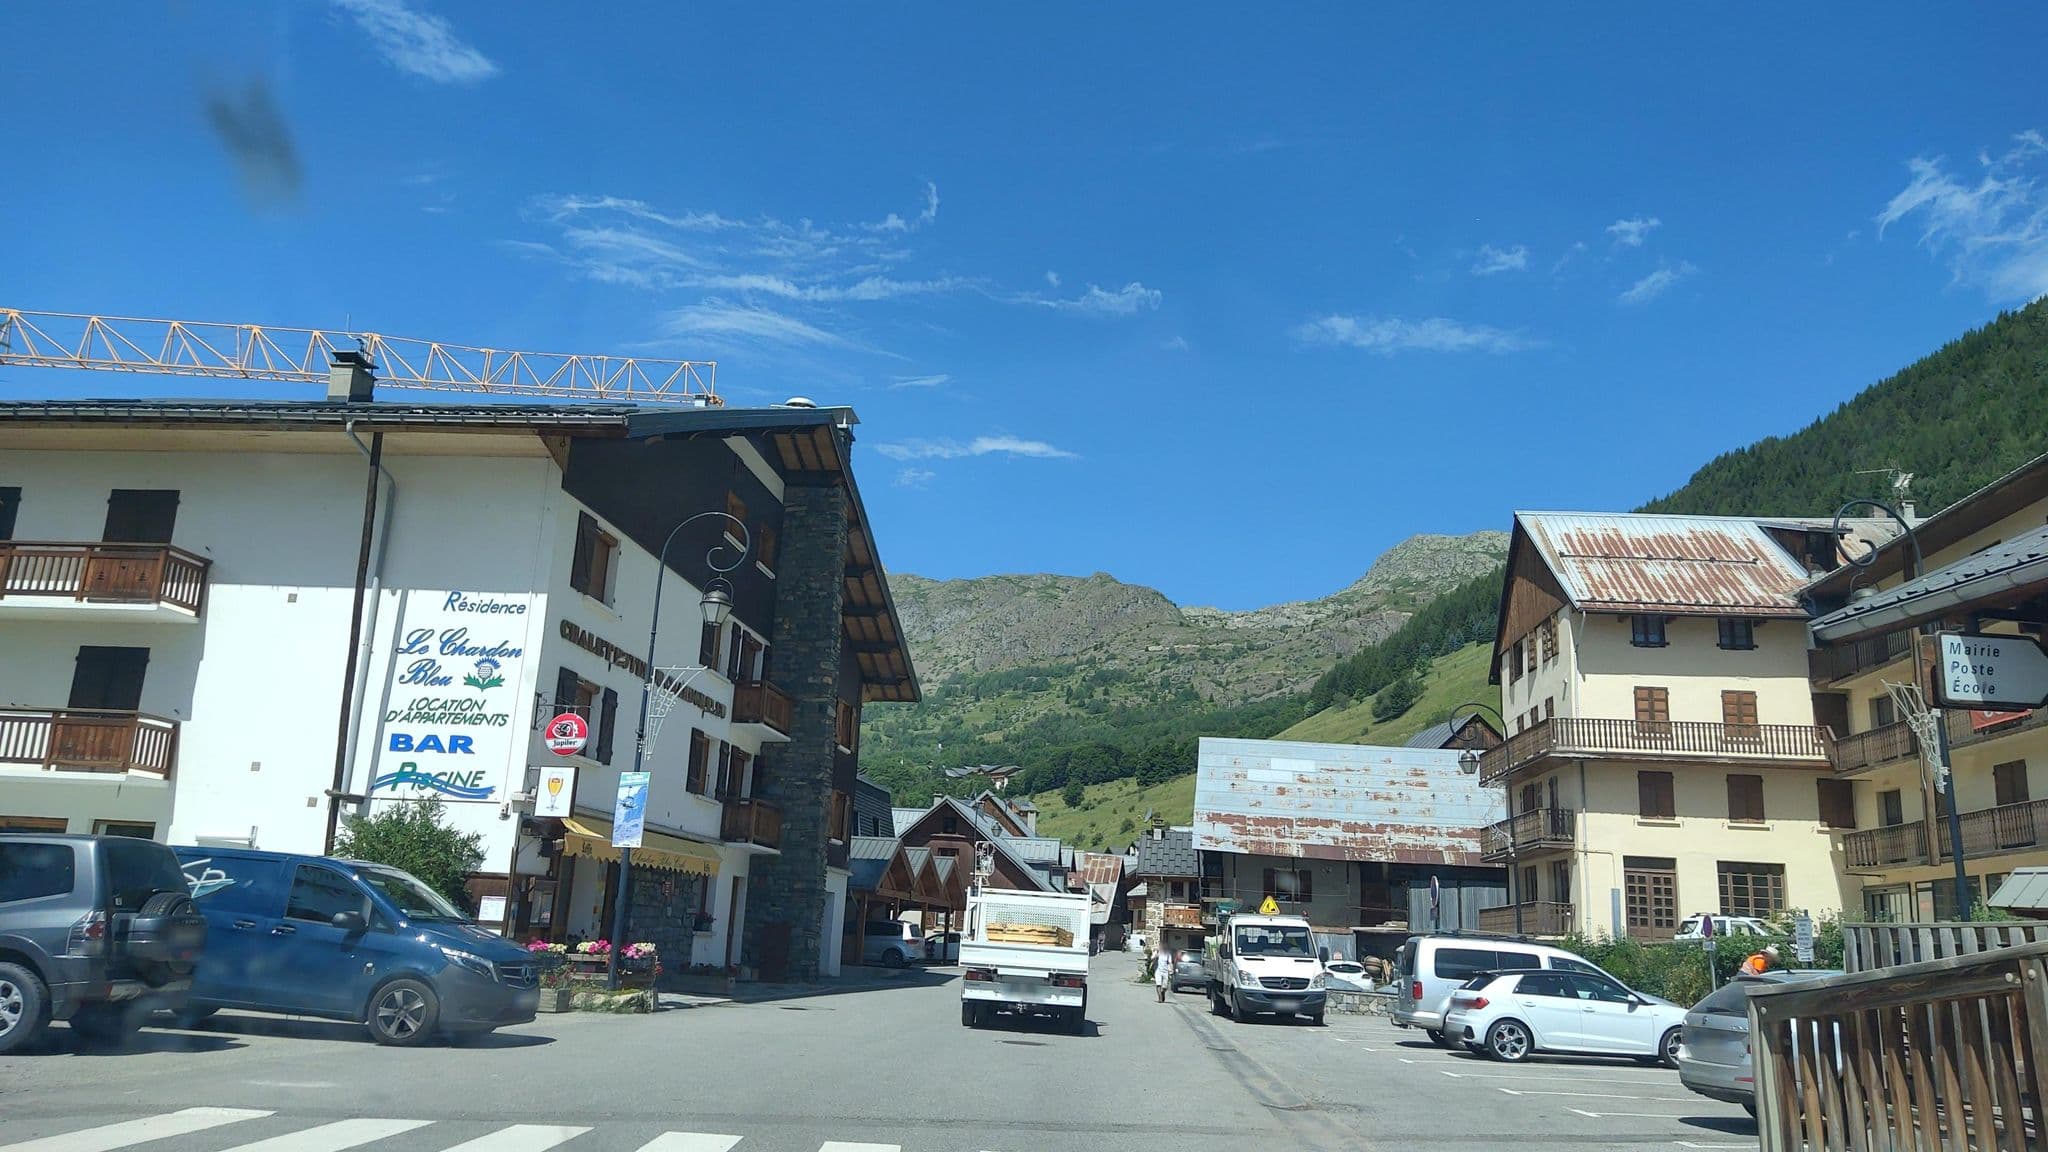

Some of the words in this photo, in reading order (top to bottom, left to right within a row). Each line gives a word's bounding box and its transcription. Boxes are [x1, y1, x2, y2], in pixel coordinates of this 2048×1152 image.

[443, 591, 527, 614] Résidence
[395, 629, 435, 654] Le
[439, 627, 523, 658] Chardon
[1949, 642, 2001, 658] Mairie
[399, 658, 454, 686] Bleu
[1951, 661, 1994, 676] Poste
[1952, 676, 1996, 695] École
[408, 697, 487, 712] LOCATION
[385, 710, 509, 727] D'APPARTEMENTS
[389, 733, 475, 754] BAR
[552, 738, 578, 747] Jupiler
